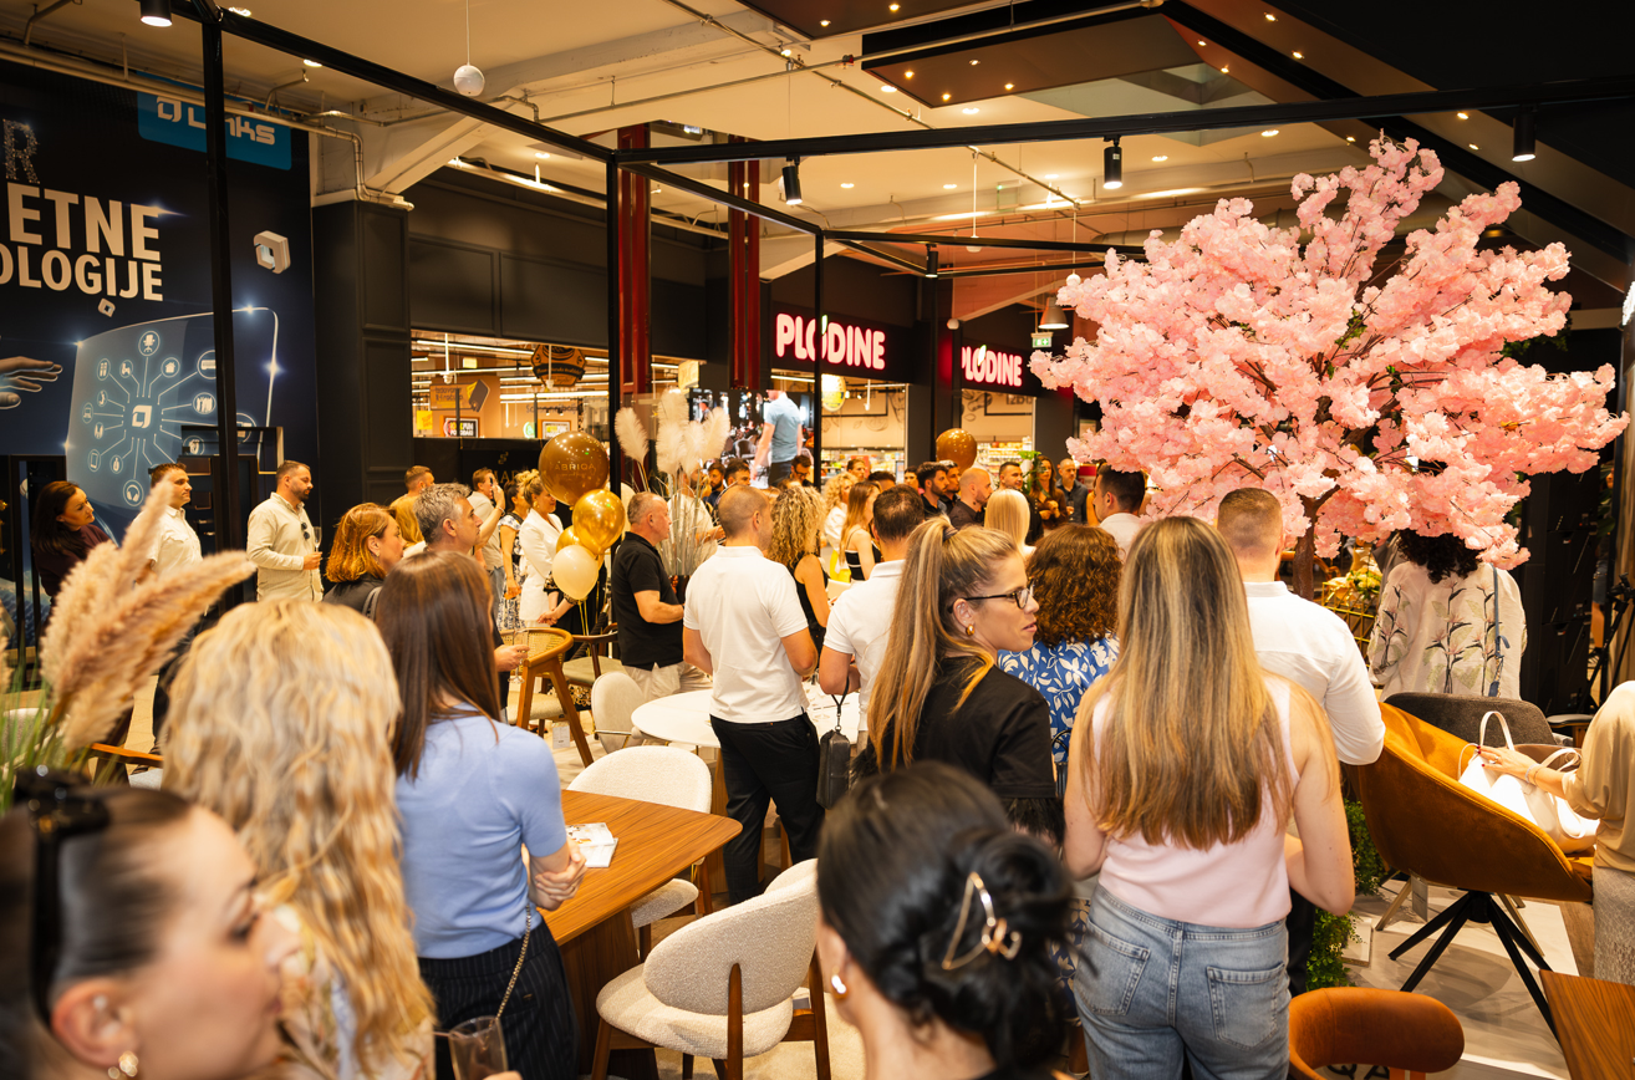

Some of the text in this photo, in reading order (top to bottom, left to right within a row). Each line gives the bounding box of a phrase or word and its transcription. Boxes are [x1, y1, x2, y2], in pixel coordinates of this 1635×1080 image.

[188, 107, 275, 145] Lnks
[7, 182, 161, 261] ETNE
[776, 313, 885, 370] PLODINE
